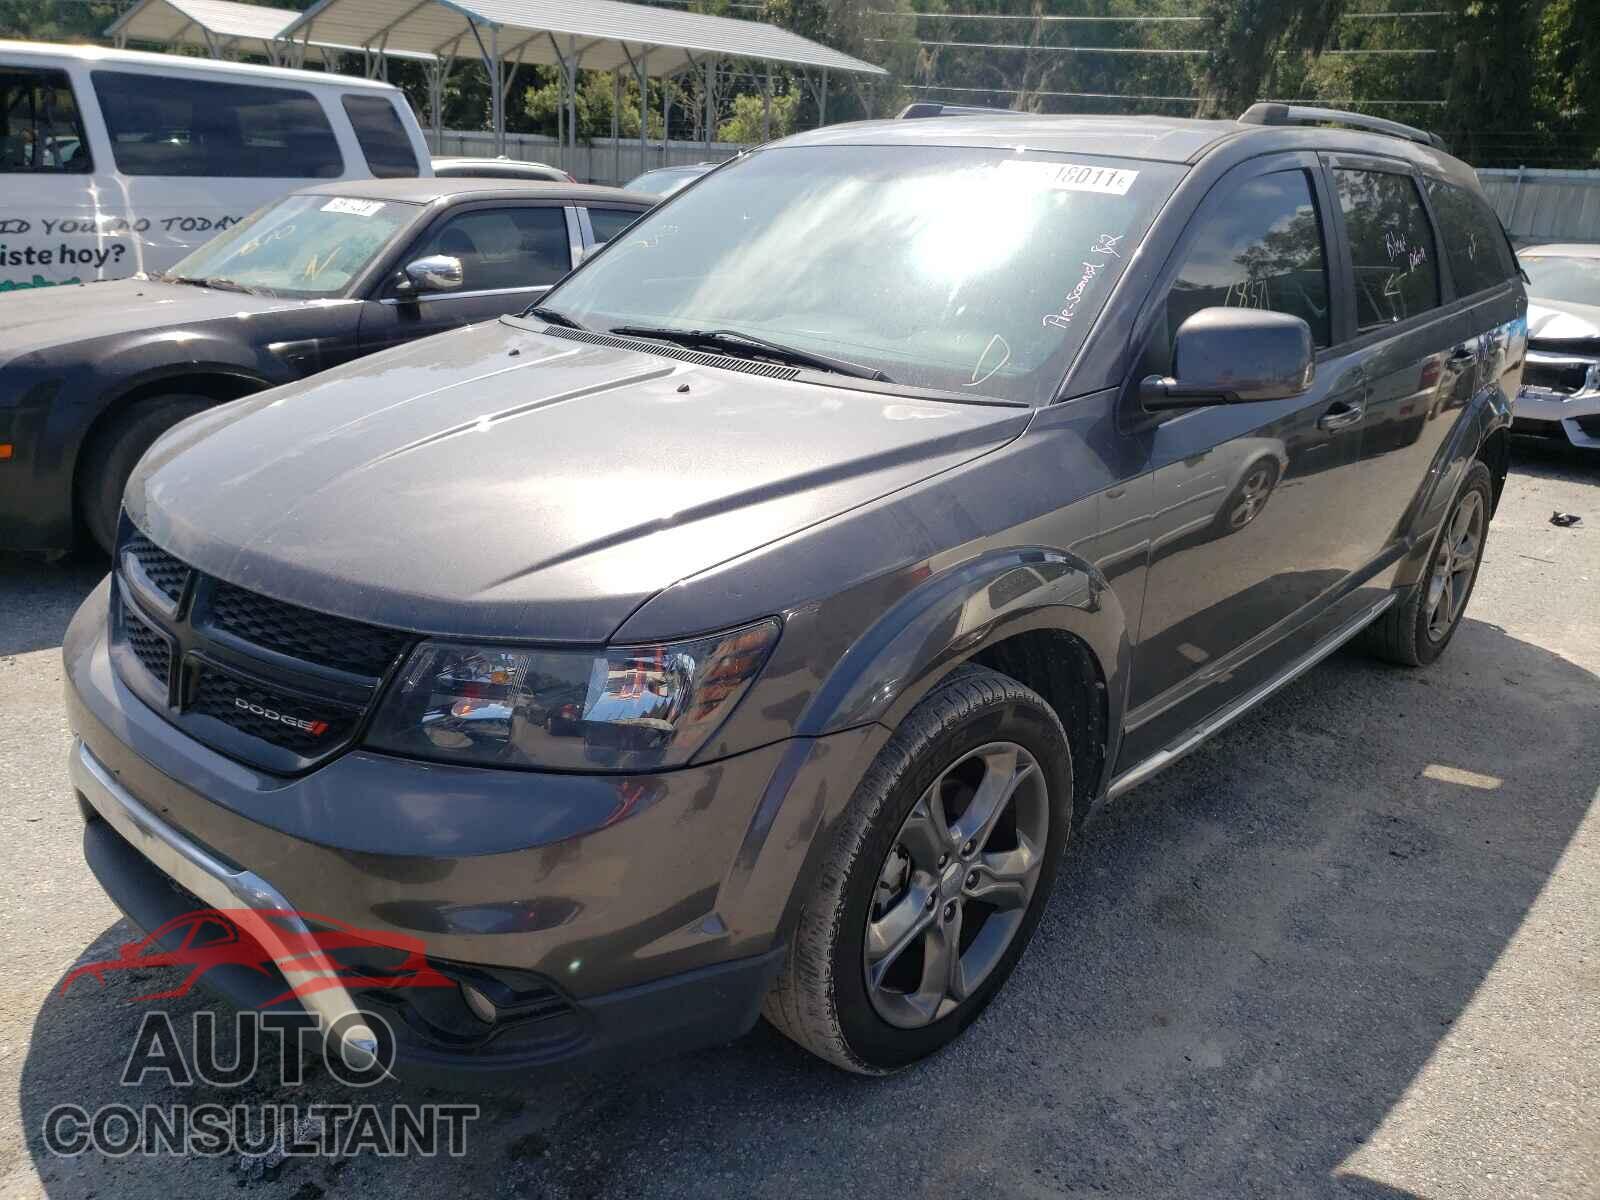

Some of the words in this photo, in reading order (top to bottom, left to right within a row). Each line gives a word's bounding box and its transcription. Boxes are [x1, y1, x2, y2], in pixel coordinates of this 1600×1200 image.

[160, 215, 243, 232] TODAY
[59, 243, 126, 268] hoy?
[235, 697, 314, 731] DODGE
